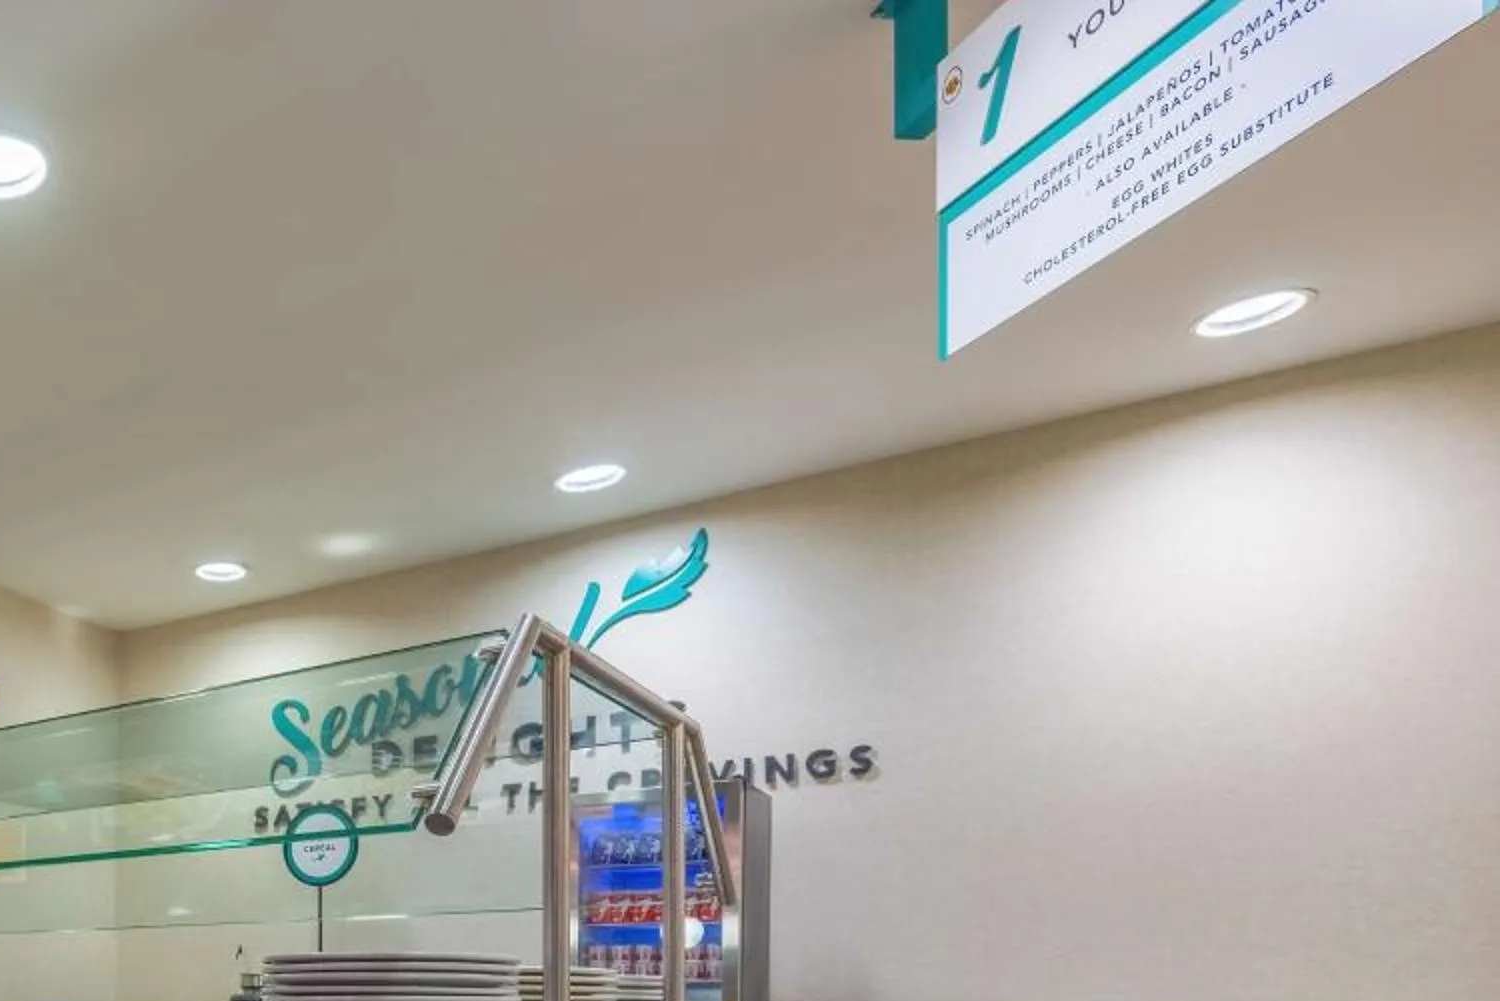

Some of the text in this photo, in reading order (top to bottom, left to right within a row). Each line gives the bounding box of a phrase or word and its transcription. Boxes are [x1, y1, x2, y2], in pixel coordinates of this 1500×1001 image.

[965, 194, 1021, 241] SPINACH
[1033, 141, 1093, 192] PEPPERS
[1218, 0, 1297, 53] TOMAT
[977, 24, 1022, 146] 1
[985, 0, 1325, 243] MUSHROOMS CHEESE BACON SAUSAG
[1095, 87, 1233, 192] ALSO AVAILABLE
[1023, 72, 1334, 285] CHOLESTEROL-FREE EGG SUBSTITUTE
[1111, 133, 1213, 210] EGG WHITES
[253, 792, 393, 832] SAFY
